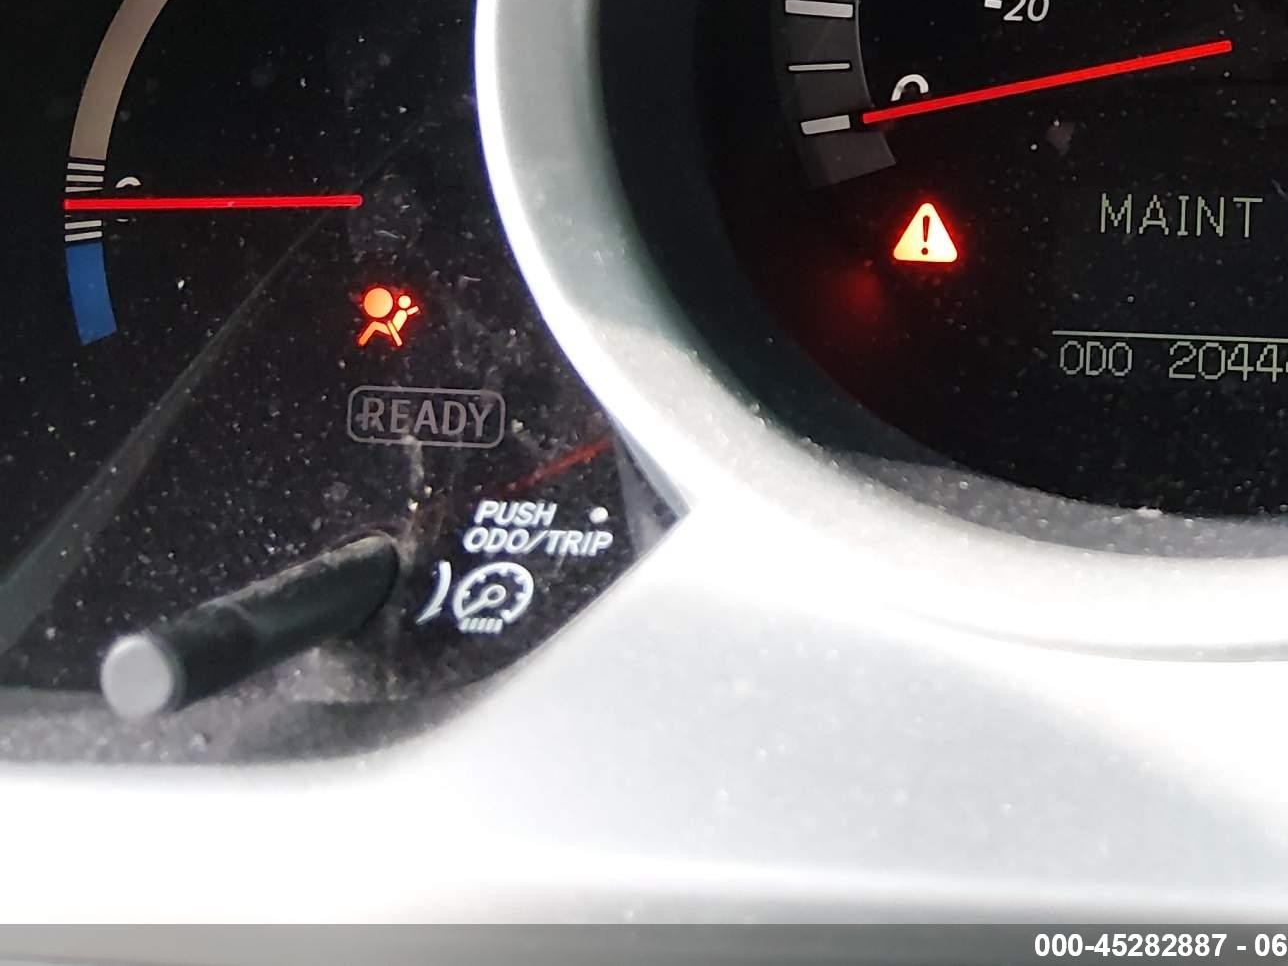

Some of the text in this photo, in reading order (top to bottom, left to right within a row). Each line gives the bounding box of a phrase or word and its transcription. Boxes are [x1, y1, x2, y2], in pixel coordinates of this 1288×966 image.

[1101, 193, 1262, 237] MAINT
[1060, 341, 1132, 376] ODO
[356, 397, 494, 436] READY
[475, 501, 557, 527] PUSH
[464, 527, 613, 556] ODO/TRIP
